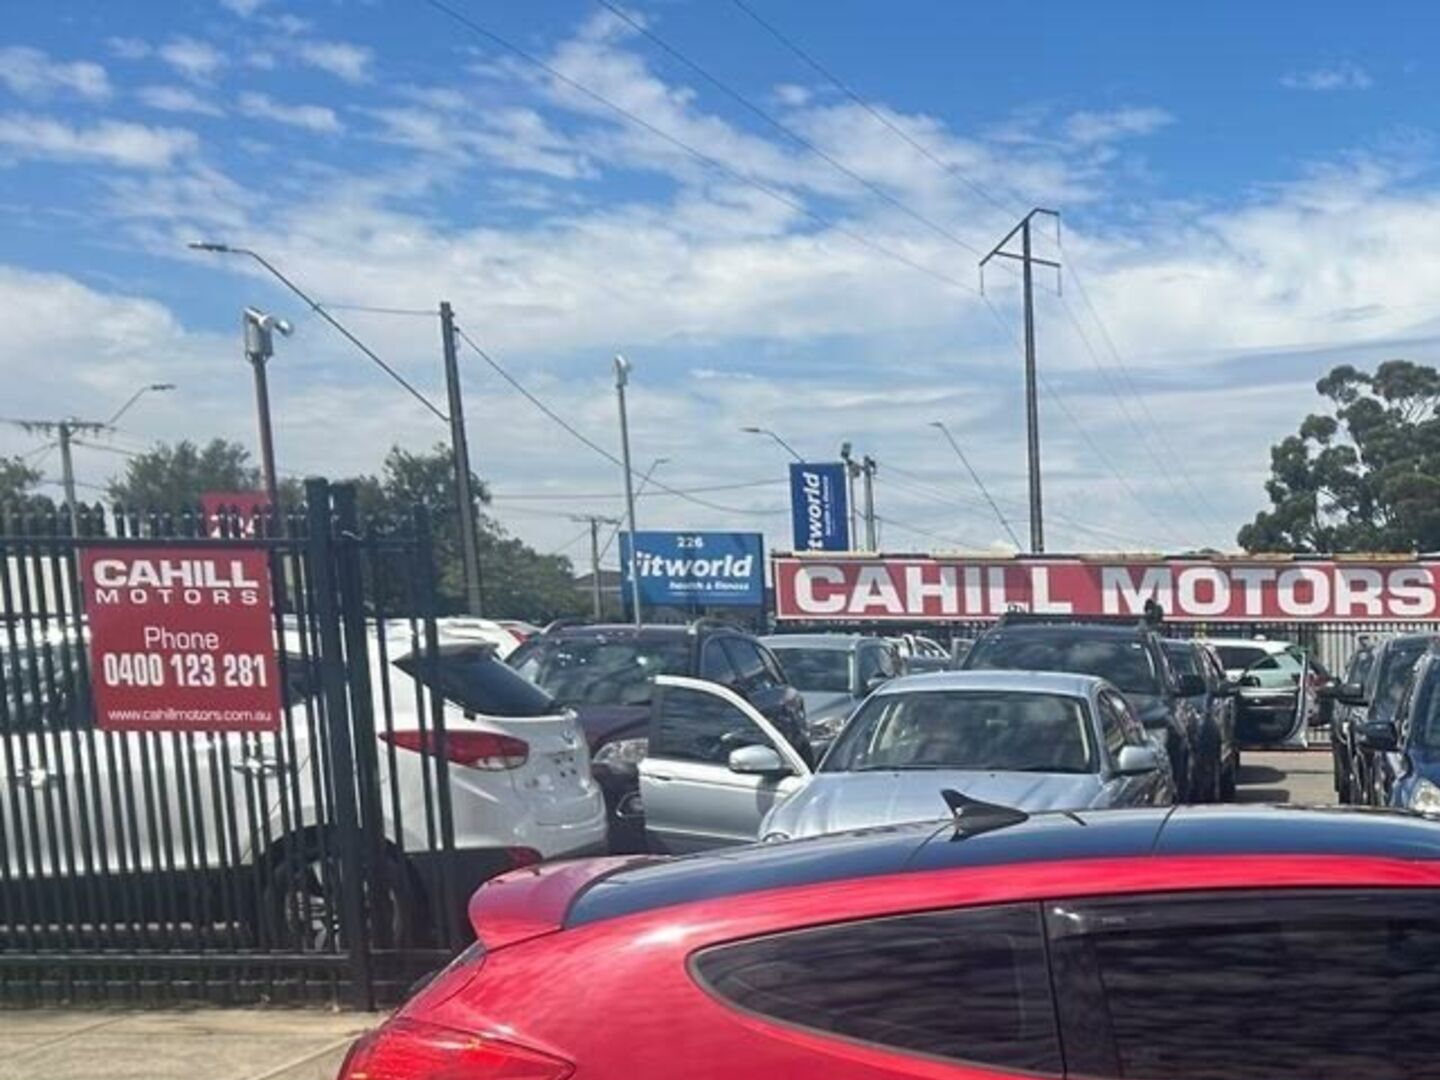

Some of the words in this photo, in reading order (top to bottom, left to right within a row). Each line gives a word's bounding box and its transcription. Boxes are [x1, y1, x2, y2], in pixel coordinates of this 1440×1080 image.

[802, 471, 824, 549] tworld
[677, 536, 703, 548] 226
[93, 559, 259, 588] CAHILL
[96, 588, 258, 604] MOTORS
[794, 566, 1073, 614] CAHILL
[1101, 566, 1437, 615] MOTORS
[144, 626, 219, 649] Phone
[103, 653, 164, 686] 0400
[171, 654, 216, 687] 123
[224, 654, 267, 687] 281
[108, 708, 271, 722] www.cahillmotors.com.au
